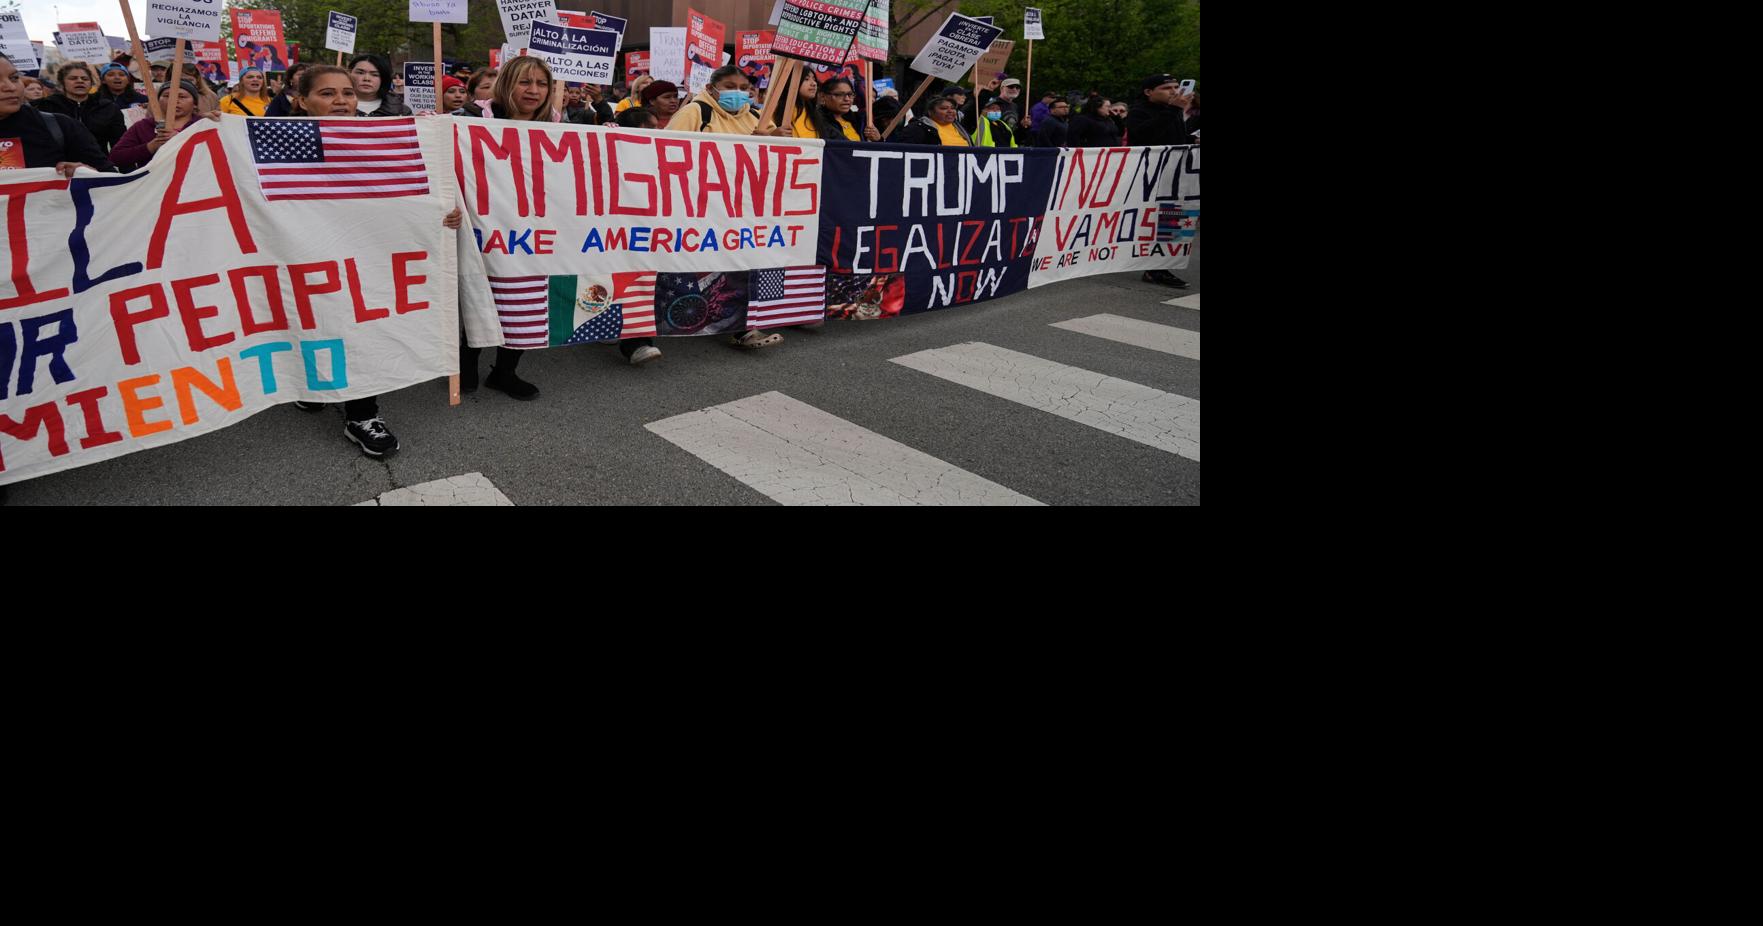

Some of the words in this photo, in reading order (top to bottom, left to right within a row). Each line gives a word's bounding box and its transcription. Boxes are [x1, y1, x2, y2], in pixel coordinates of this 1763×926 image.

[151, 3, 218, 17] RECHAZAMOS
[501, 1, 551, 12] TAXPAYER
[799, 0, 824, 12] POLICE
[827, 5, 862, 19] CRIMES
[0, 15, 20, 23] OR:
[510, 9, 547, 22] DATA!
[593, 15, 607, 25] TOP
[799, 7, 838, 24] LGBTQIA+
[839, 19, 859, 28] AND
[157, 17, 211, 29] VIGILANCIA
[823, 23, 855, 36] RIGHTS
[533, 28, 559, 40] ¡ALTO
[571, 34, 588, 44] LA
[816, 30, 840, 40] RIGHTS
[949, 32, 981, 46] OBRERA!
[956, 28, 982, 40] CLASE
[147, 39, 171, 48] STOP
[789, 39, 836, 55] EDUCATION
[937, 38, 980, 56] PAGAMOS
[799, 47, 844, 63] FREEDOM
[928, 52, 954, 64] ¡PAGA
[954, 59, 966, 67] LA
[574, 58, 584, 68] A
[586, 61, 610, 70] LAS
[931, 59, 955, 71] TUYA!
[549, 65, 609, 79] ORTACIONES!
[852, 150, 1025, 219] TRUMP
[1055, 207, 1157, 252] VAMOS
[581, 227, 719, 253] AMERICA
[722, 225, 804, 251] GREAT
[1031, 256, 1053, 272] WE
[1056, 251, 1081, 269] ARE
[1088, 246, 1118, 262] NOT
[1131, 242, 1193, 257] LEAVI
[927, 266, 1008, 309] NOW
[109, 250, 430, 366] PEOPLE
